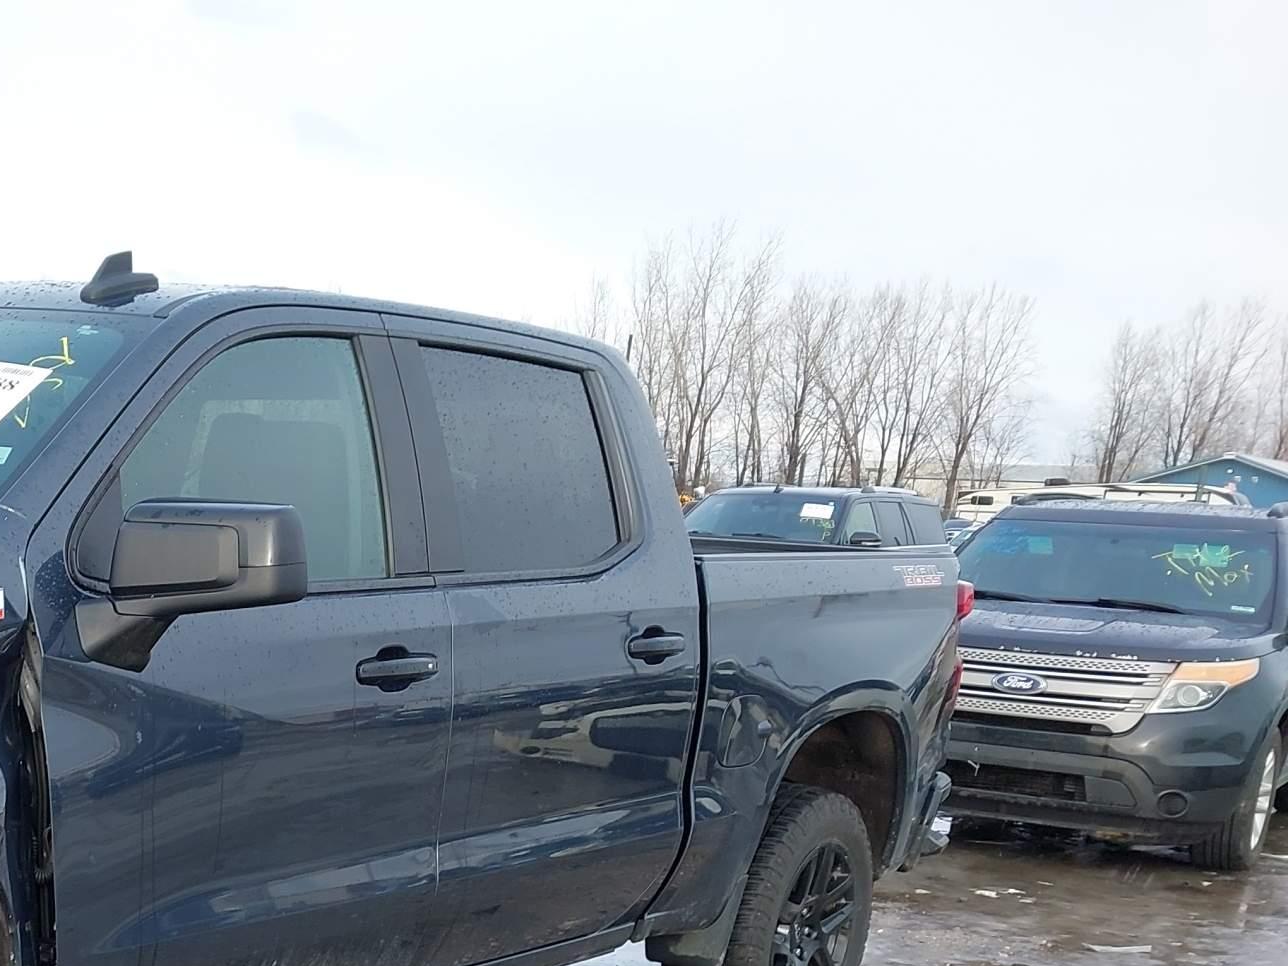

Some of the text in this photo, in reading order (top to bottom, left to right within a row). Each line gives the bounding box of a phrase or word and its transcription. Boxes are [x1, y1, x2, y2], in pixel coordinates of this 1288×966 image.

[893, 564, 944, 577] TRAIL
[904, 575, 942, 586] BOSS
[1003, 675, 1034, 689] Ford
